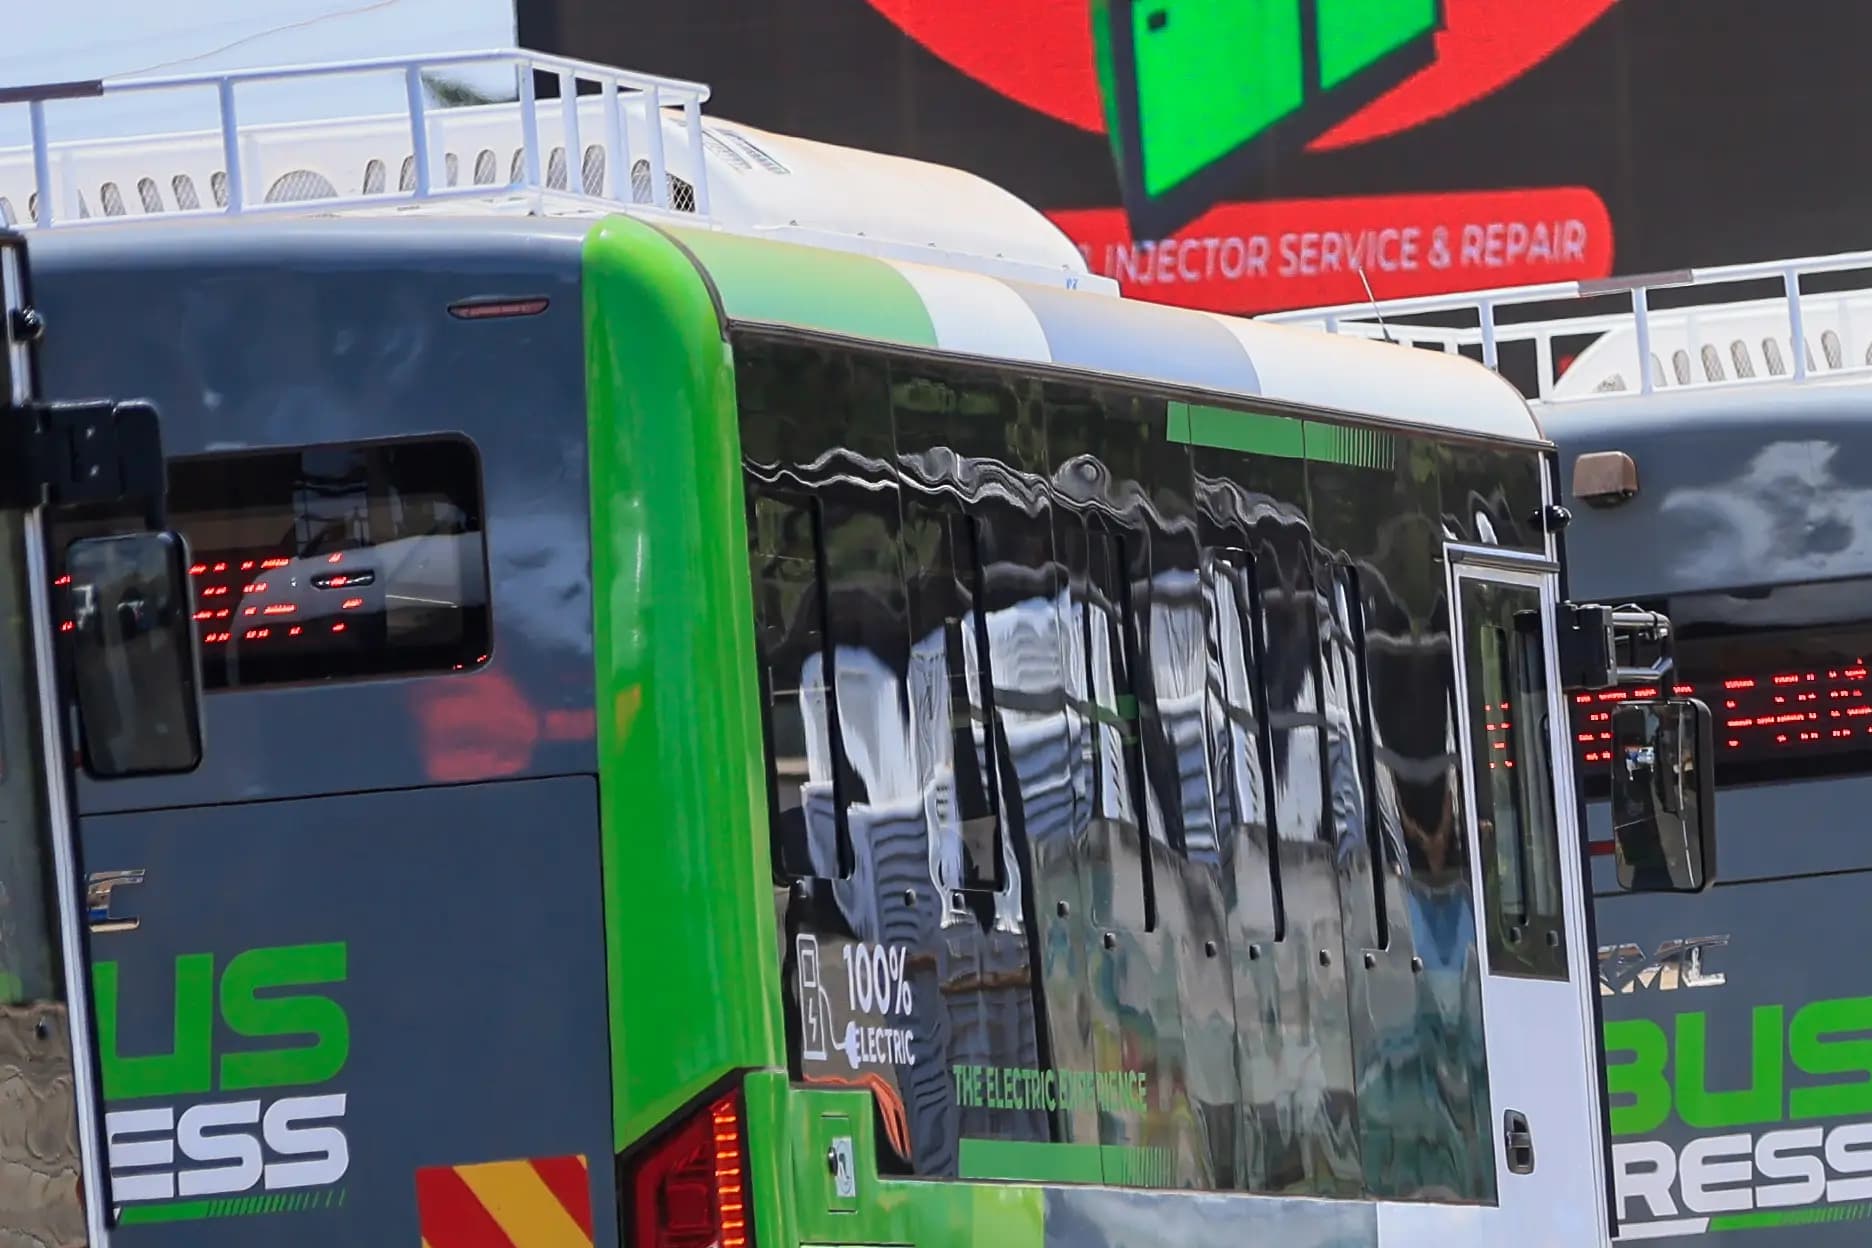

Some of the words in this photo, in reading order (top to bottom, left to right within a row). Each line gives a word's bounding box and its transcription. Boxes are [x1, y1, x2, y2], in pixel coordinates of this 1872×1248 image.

[1105, 234, 1269, 284] INJECTOR
[1278, 228, 1420, 277] SERVICE
[1427, 226, 1451, 269] &
[1460, 219, 1588, 267] REPAIR
[843, 942, 913, 1016] 100%
[844, 1021, 916, 1069] ELECTRIC
[952, 1064, 983, 1107] THE
[986, 1066, 1056, 1112] ELECTRIC
[105, 1093, 350, 1202] ESS
